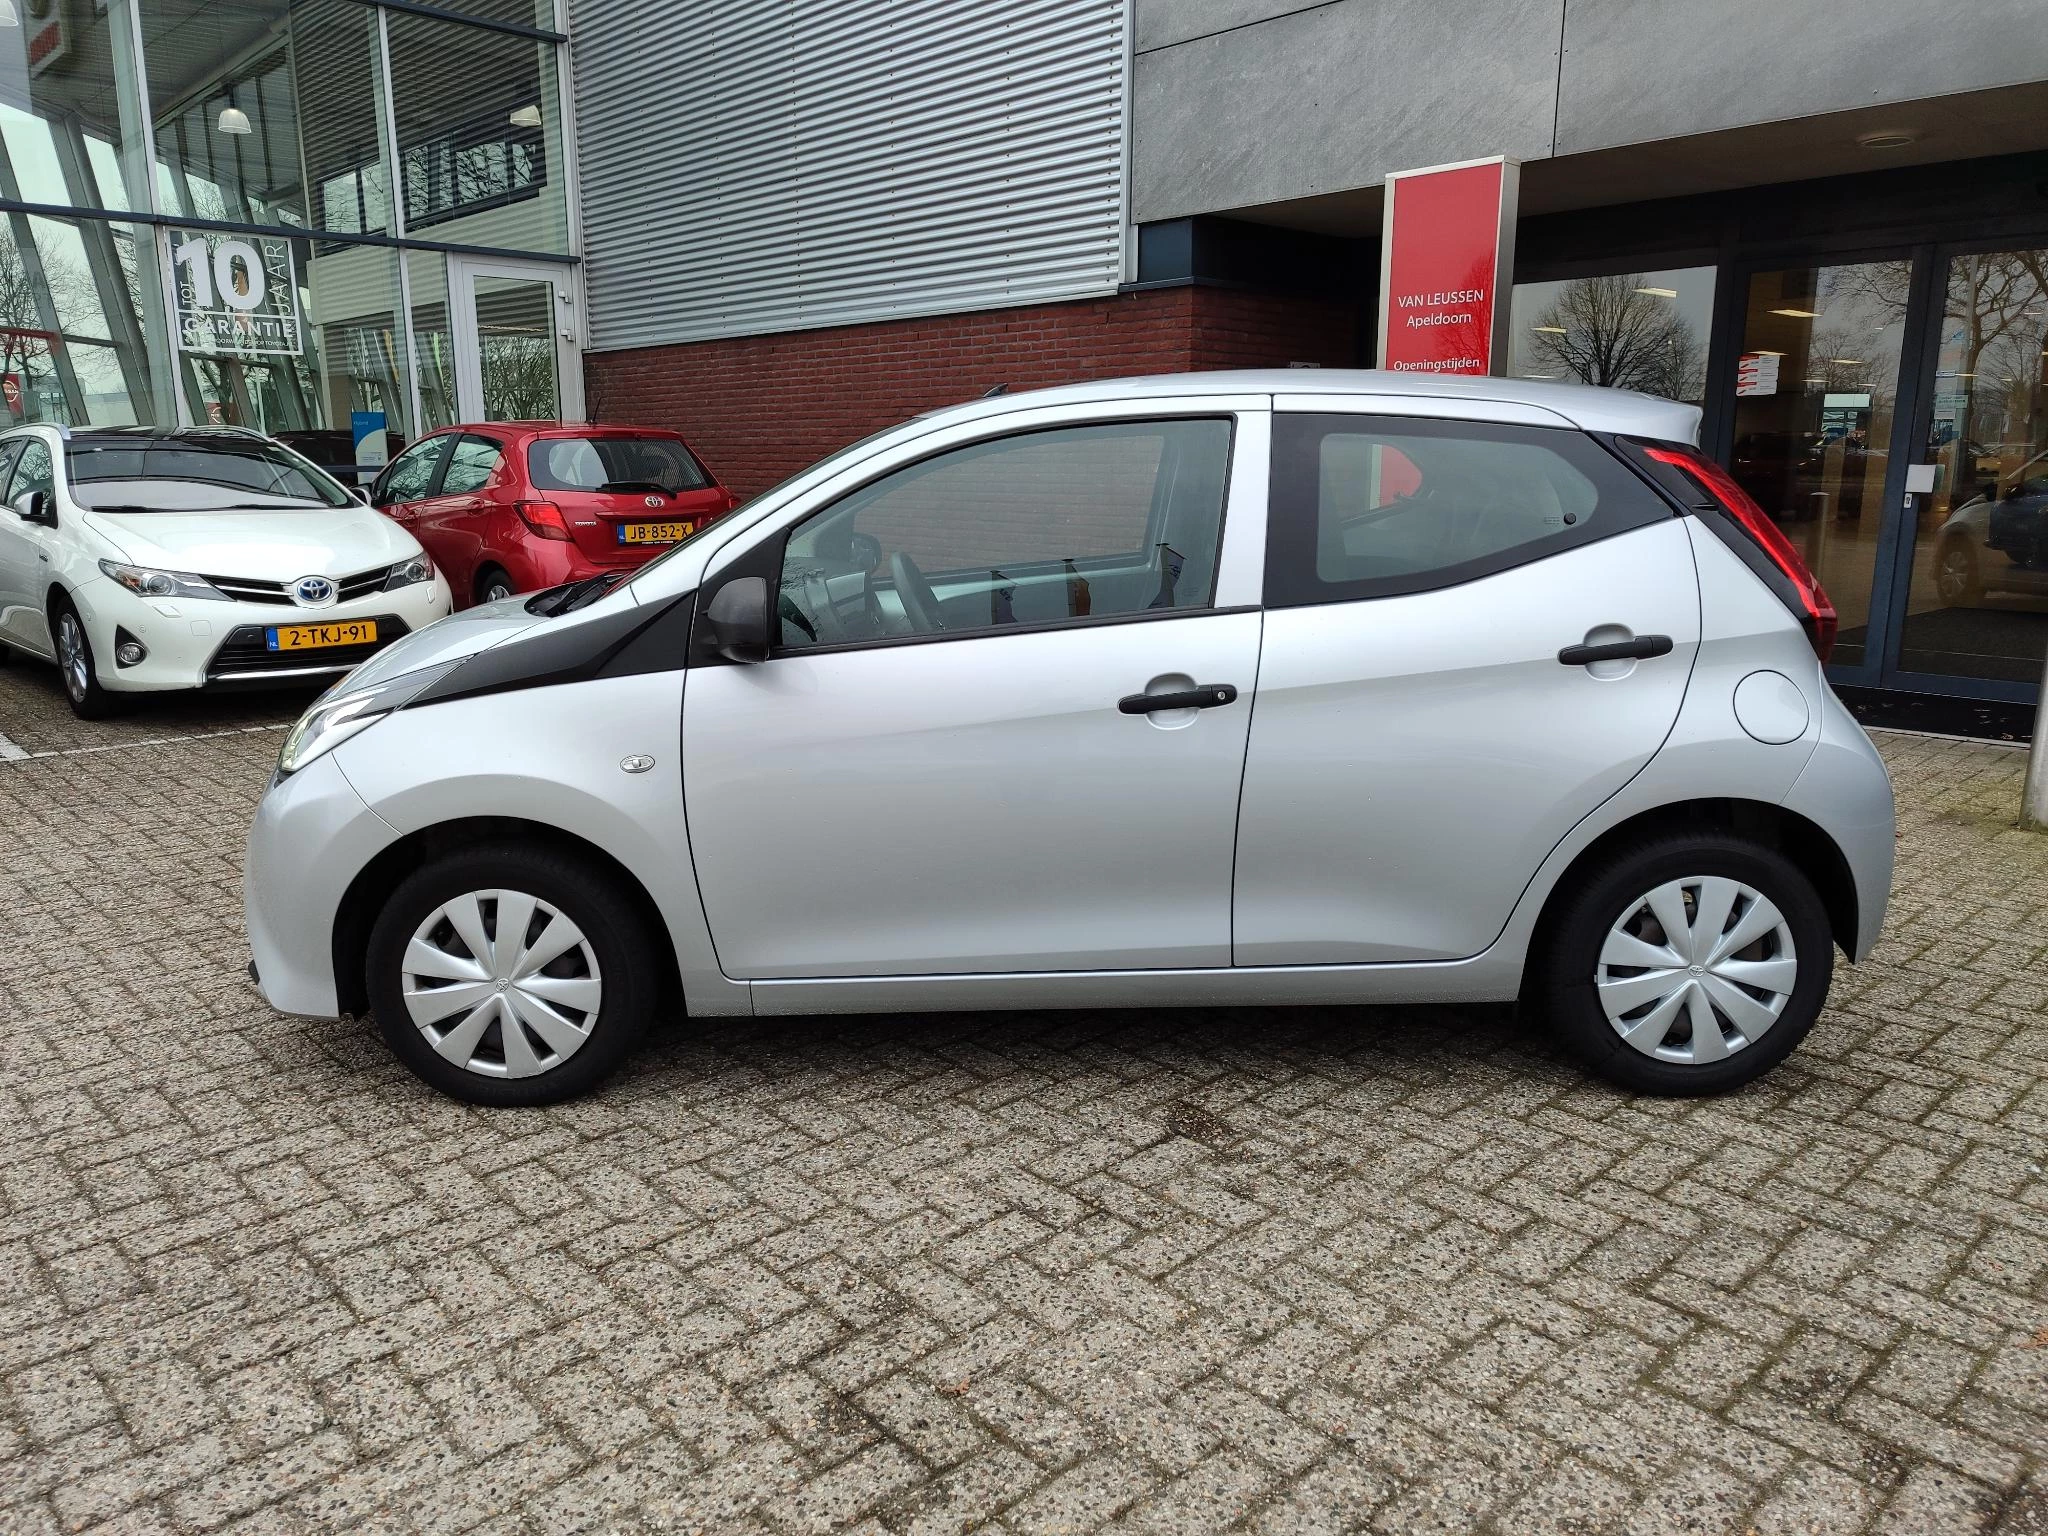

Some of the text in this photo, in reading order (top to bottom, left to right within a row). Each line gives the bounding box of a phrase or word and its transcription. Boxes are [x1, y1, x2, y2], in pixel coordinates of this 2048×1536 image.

[175, 238, 264, 309] 10
[265, 245, 290, 312] JAAR
[180, 281, 194, 305] TOT
[1398, 289, 1484, 308] VAN LEUSSEN
[184, 317, 294, 338] GARANTIE
[1406, 312, 1472, 329] Apeldoorn
[1394, 357, 1480, 372] Openingstijden
[630, 524, 688, 540] JB-852-X
[289, 625, 367, 646] 2-TKJ-91
